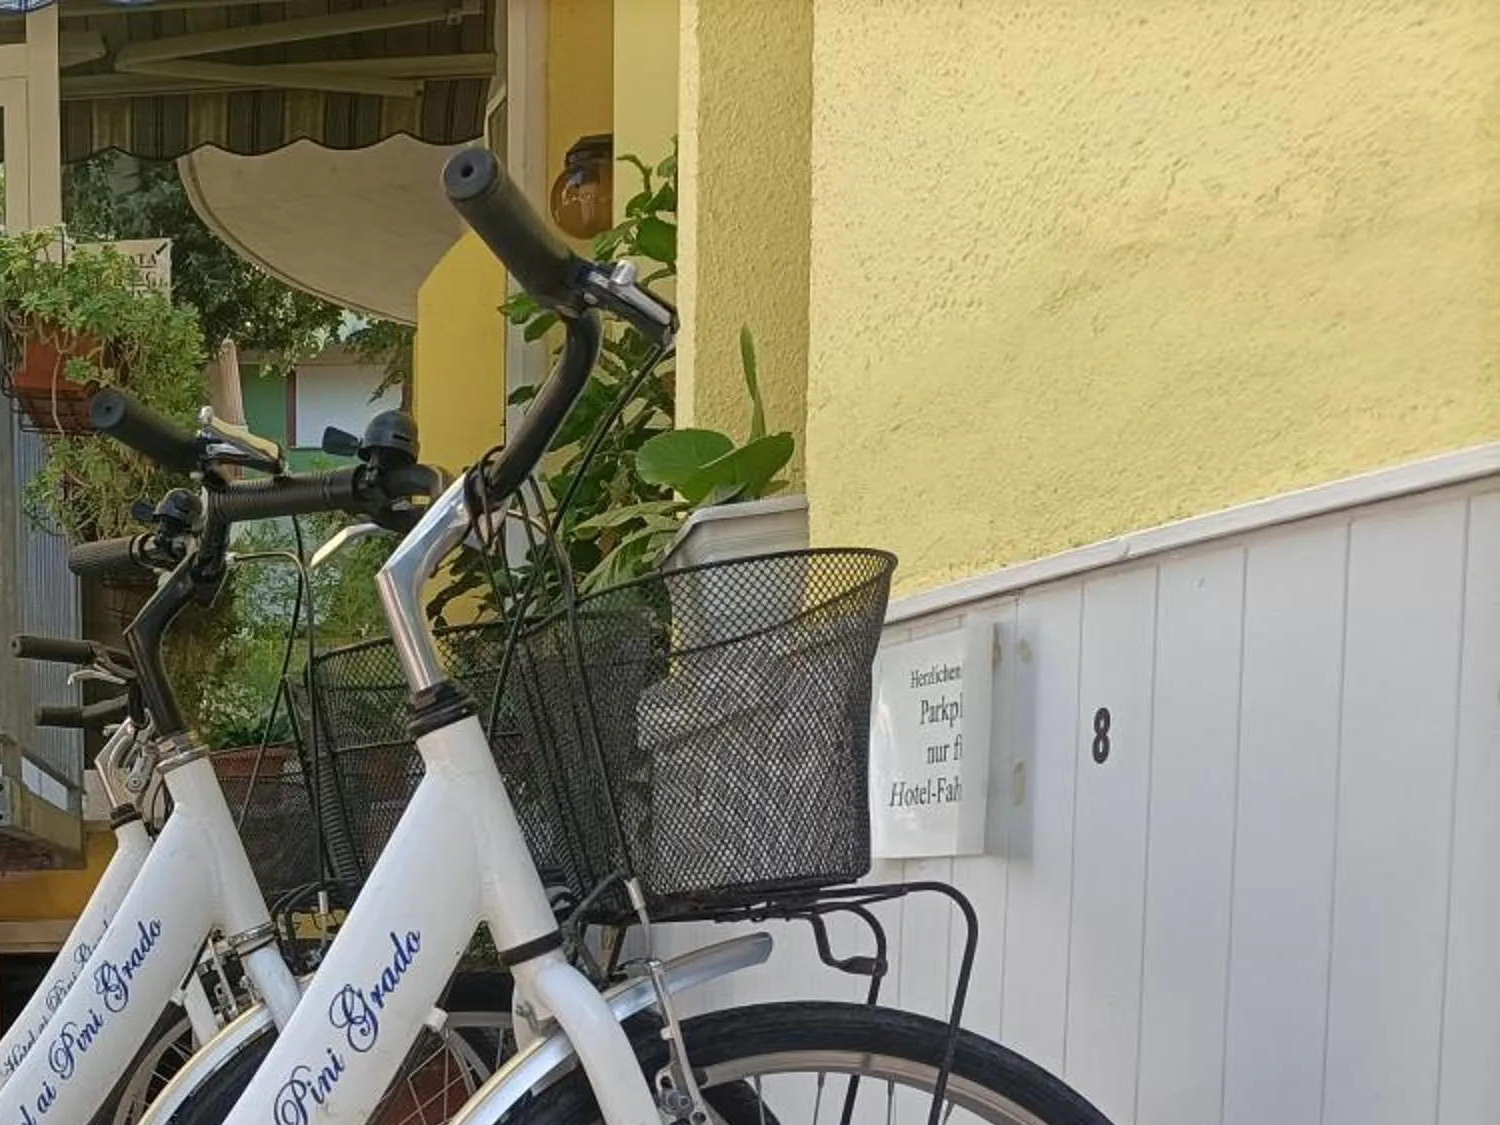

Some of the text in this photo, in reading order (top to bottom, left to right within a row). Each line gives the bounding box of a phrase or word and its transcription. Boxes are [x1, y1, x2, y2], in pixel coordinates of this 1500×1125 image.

[927, 744, 950, 764] nur
[1092, 707, 1110, 764] 8
[37, 1080, 58, 1113] ai
[49, 1009, 104, 1080] Pini
[93, 919, 162, 1013] Grado
[329, 930, 421, 1053] Grado
